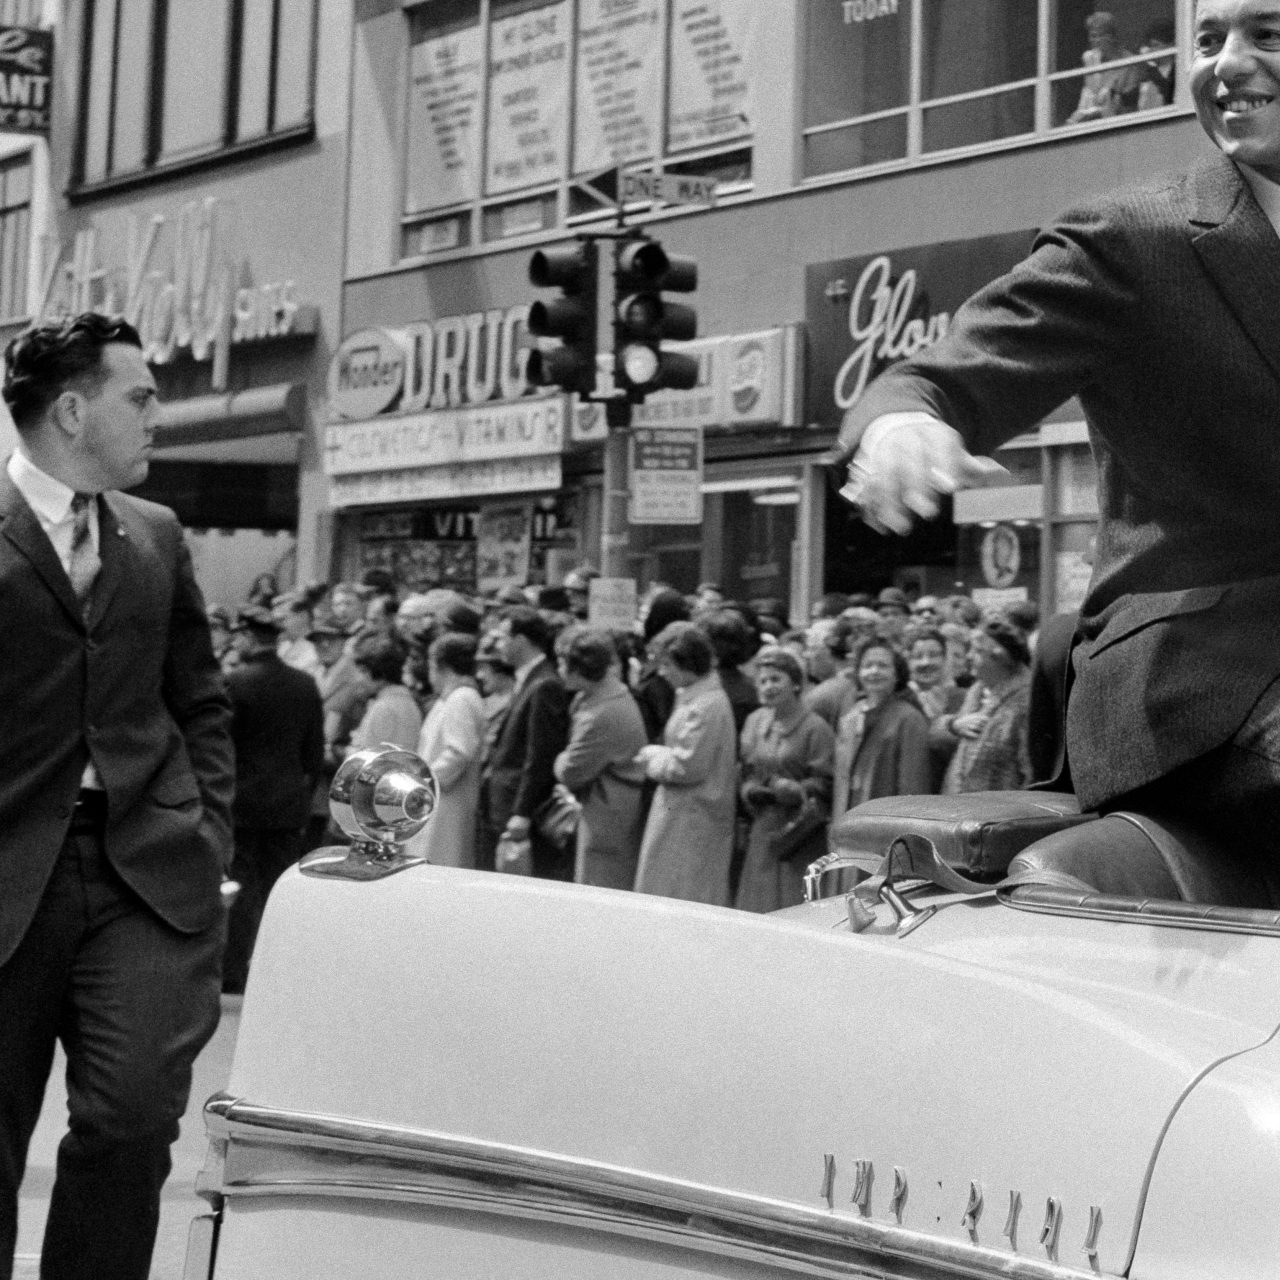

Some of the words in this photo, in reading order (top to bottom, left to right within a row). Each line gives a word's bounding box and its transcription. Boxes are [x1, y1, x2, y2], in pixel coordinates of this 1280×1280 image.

[623, 174, 664, 200] ONE
[677, 178, 716, 205] WAY
[834, 255, 950, 409] Glov
